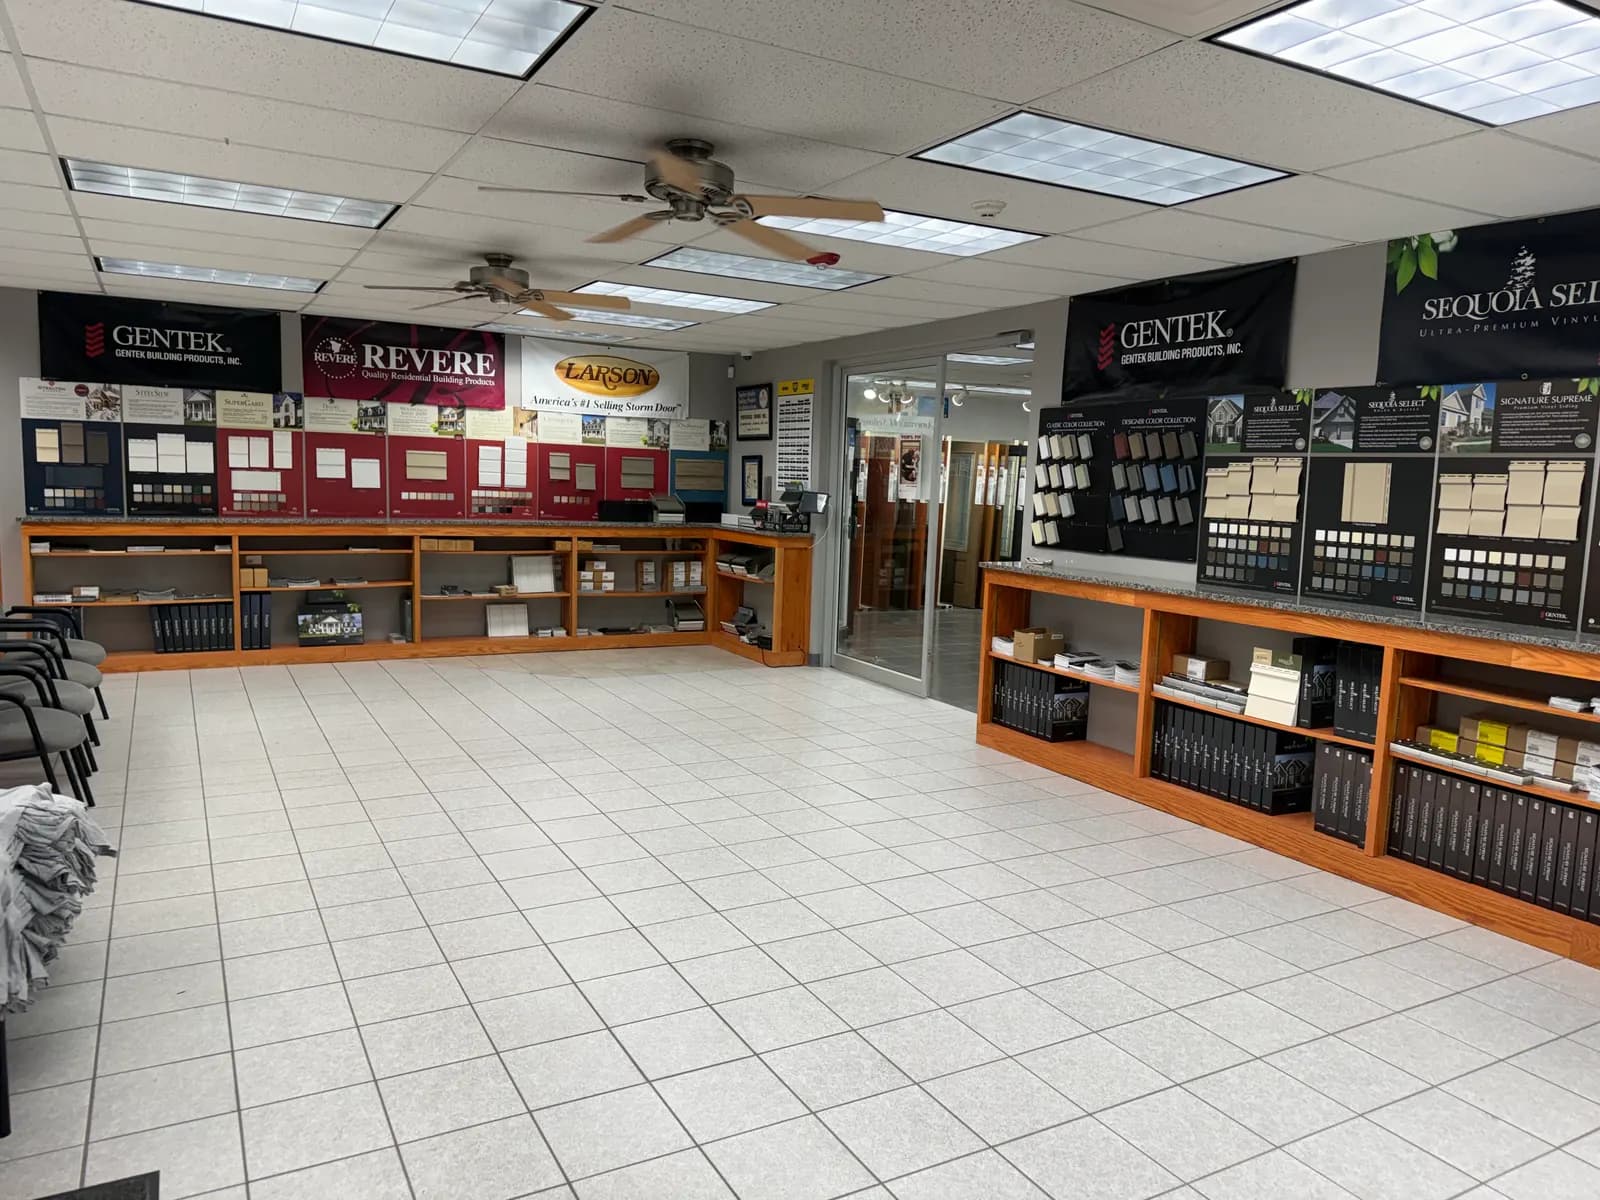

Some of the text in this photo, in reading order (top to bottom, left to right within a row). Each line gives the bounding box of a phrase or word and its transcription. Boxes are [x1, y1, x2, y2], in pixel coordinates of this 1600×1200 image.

[1422, 286, 1544, 321] SEQUOIA
[1551, 314, 1598, 326] VINYL
[115, 348, 242, 366] GENTEK BUILDING PRODUCTS, INC.
[314, 351, 358, 365] REVERE
[362, 343, 496, 377] REVERE
[1121, 342, 1244, 365] GENTEK BUILDING PRODUCTS, INC.
[361, 369, 496, 387] Quality Residential Building Products
[565, 363, 652, 391] LARSON
[530, 395, 578, 407] America's
[580, 400, 590, 408] #1
[593, 399, 624, 412] Selling
[625, 401, 653, 412] Storm
[1399, 399, 1427, 407] SELECT
[1500, 394, 1593, 406] SIGNATURE SUPREME
[1163, 415, 1197, 424] COLLECTION
